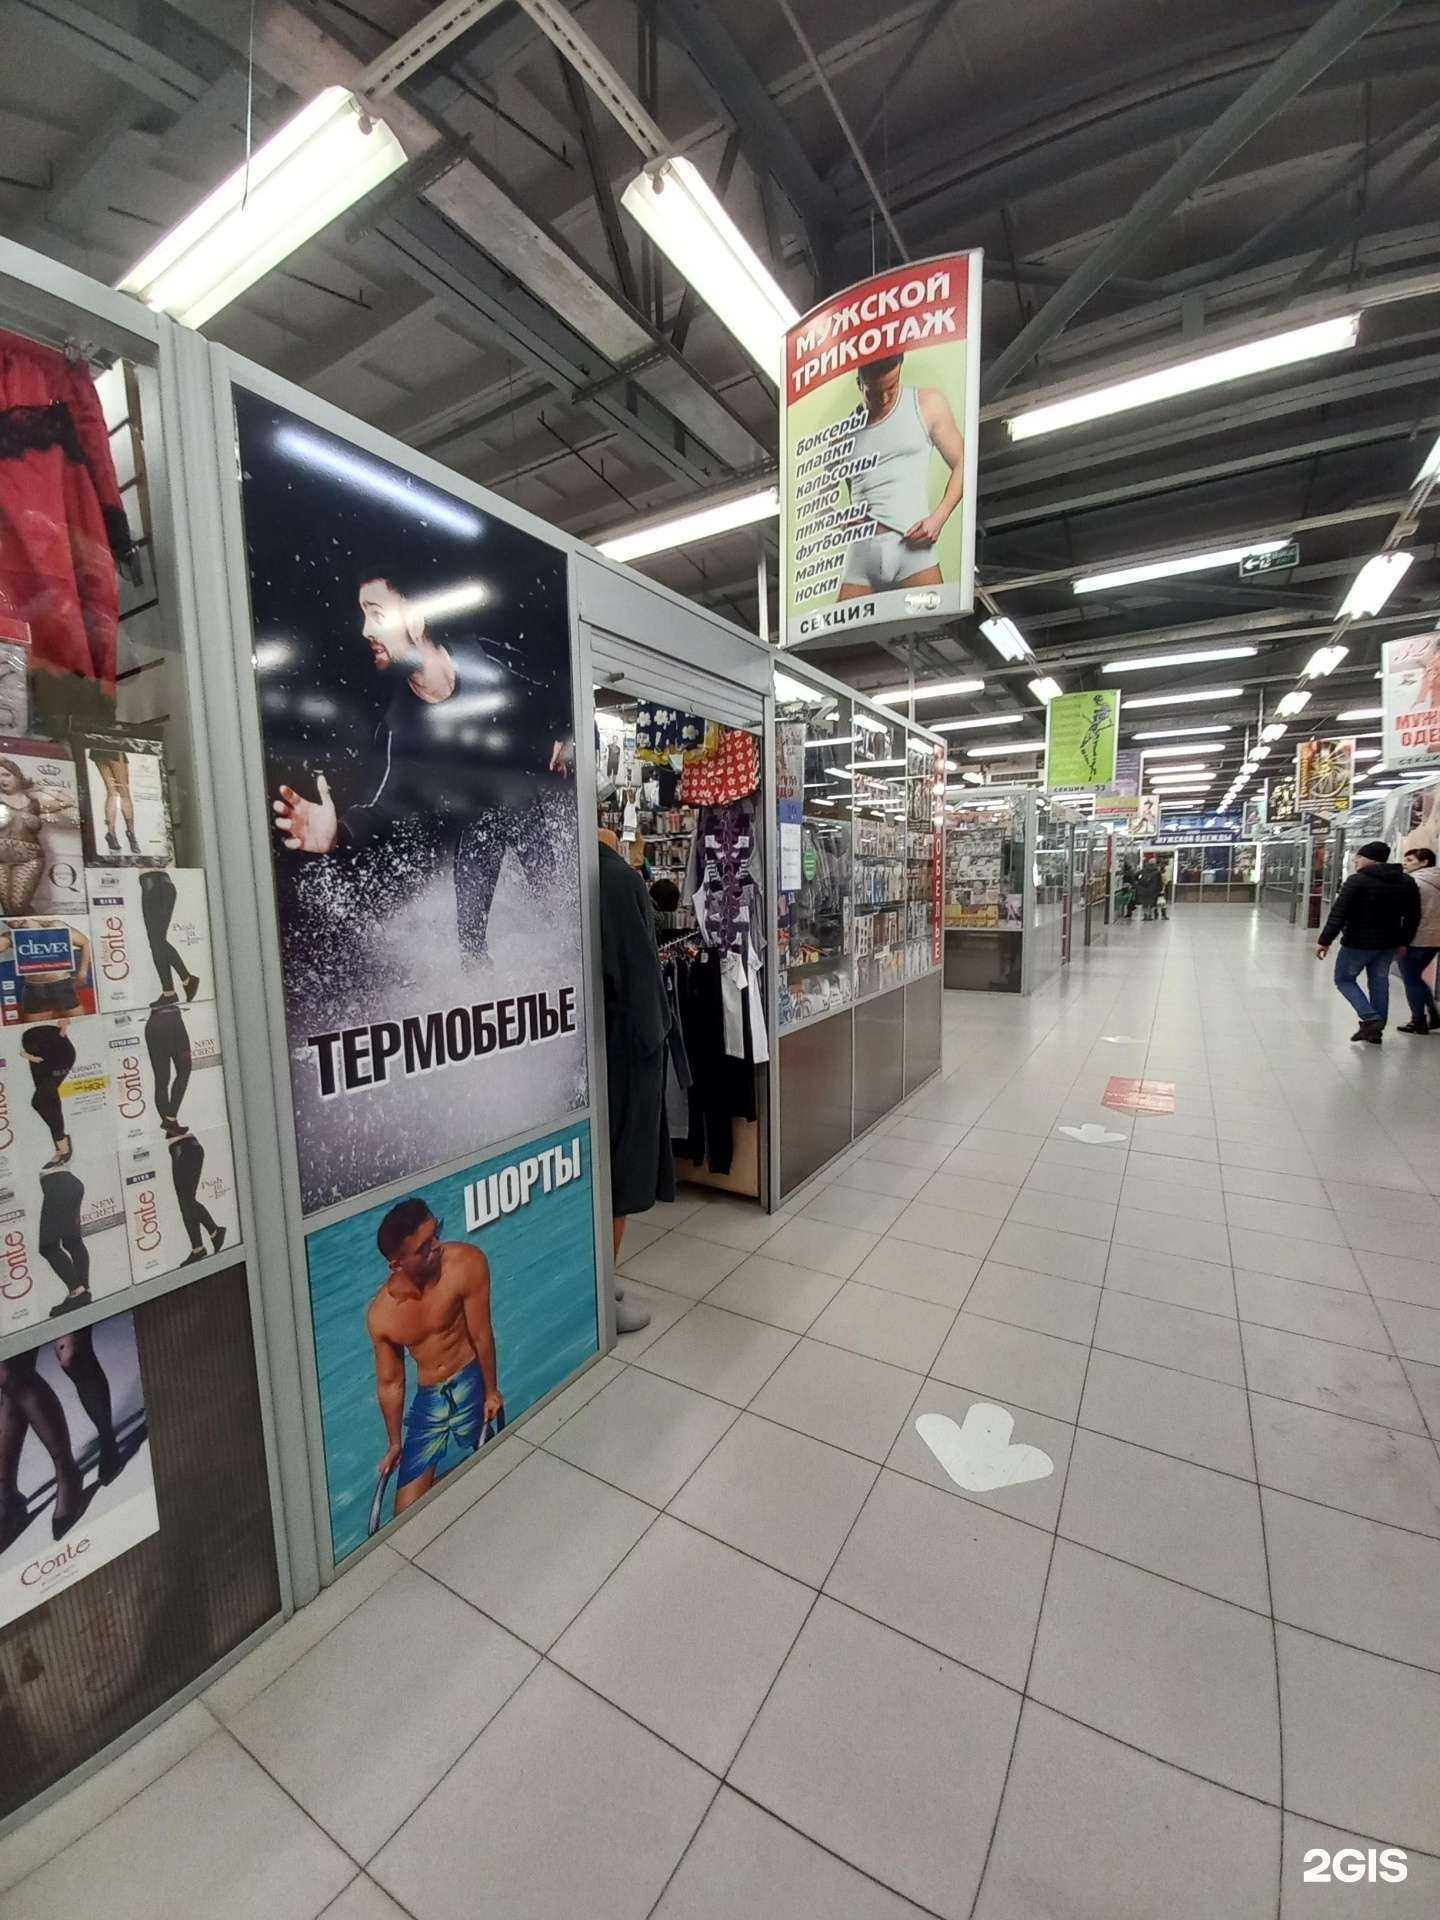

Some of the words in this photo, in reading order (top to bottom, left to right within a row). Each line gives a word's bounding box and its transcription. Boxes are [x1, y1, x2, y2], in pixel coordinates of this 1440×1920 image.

[797, 271, 950, 360] МУЖСКОЙ
[792, 306, 956, 393] ТРИКОТАЖ
[797, 411, 867, 456] боксеры
[796, 455, 878, 499] кальсоны
[797, 441, 854, 478] плавки
[796, 490, 840, 520] трико
[796, 503, 868, 541] пижамы
[796, 523, 876, 563] футболки
[795, 554, 845, 582] майки
[795, 577, 838, 602] носки
[800, 602, 875, 634] СЕКЦИЯ
[100, 916, 130, 981] Conte
[307, 986, 577, 1097] ТЕРМОБЕЛЬЕ
[117, 1056, 146, 1119] Conte
[464, 1137, 581, 1233] ШОРТЫ
[133, 1190, 162, 1251] Conte
[0, 1230, 33, 1300] Conte
[21, 1538, 90, 1586] Conte
